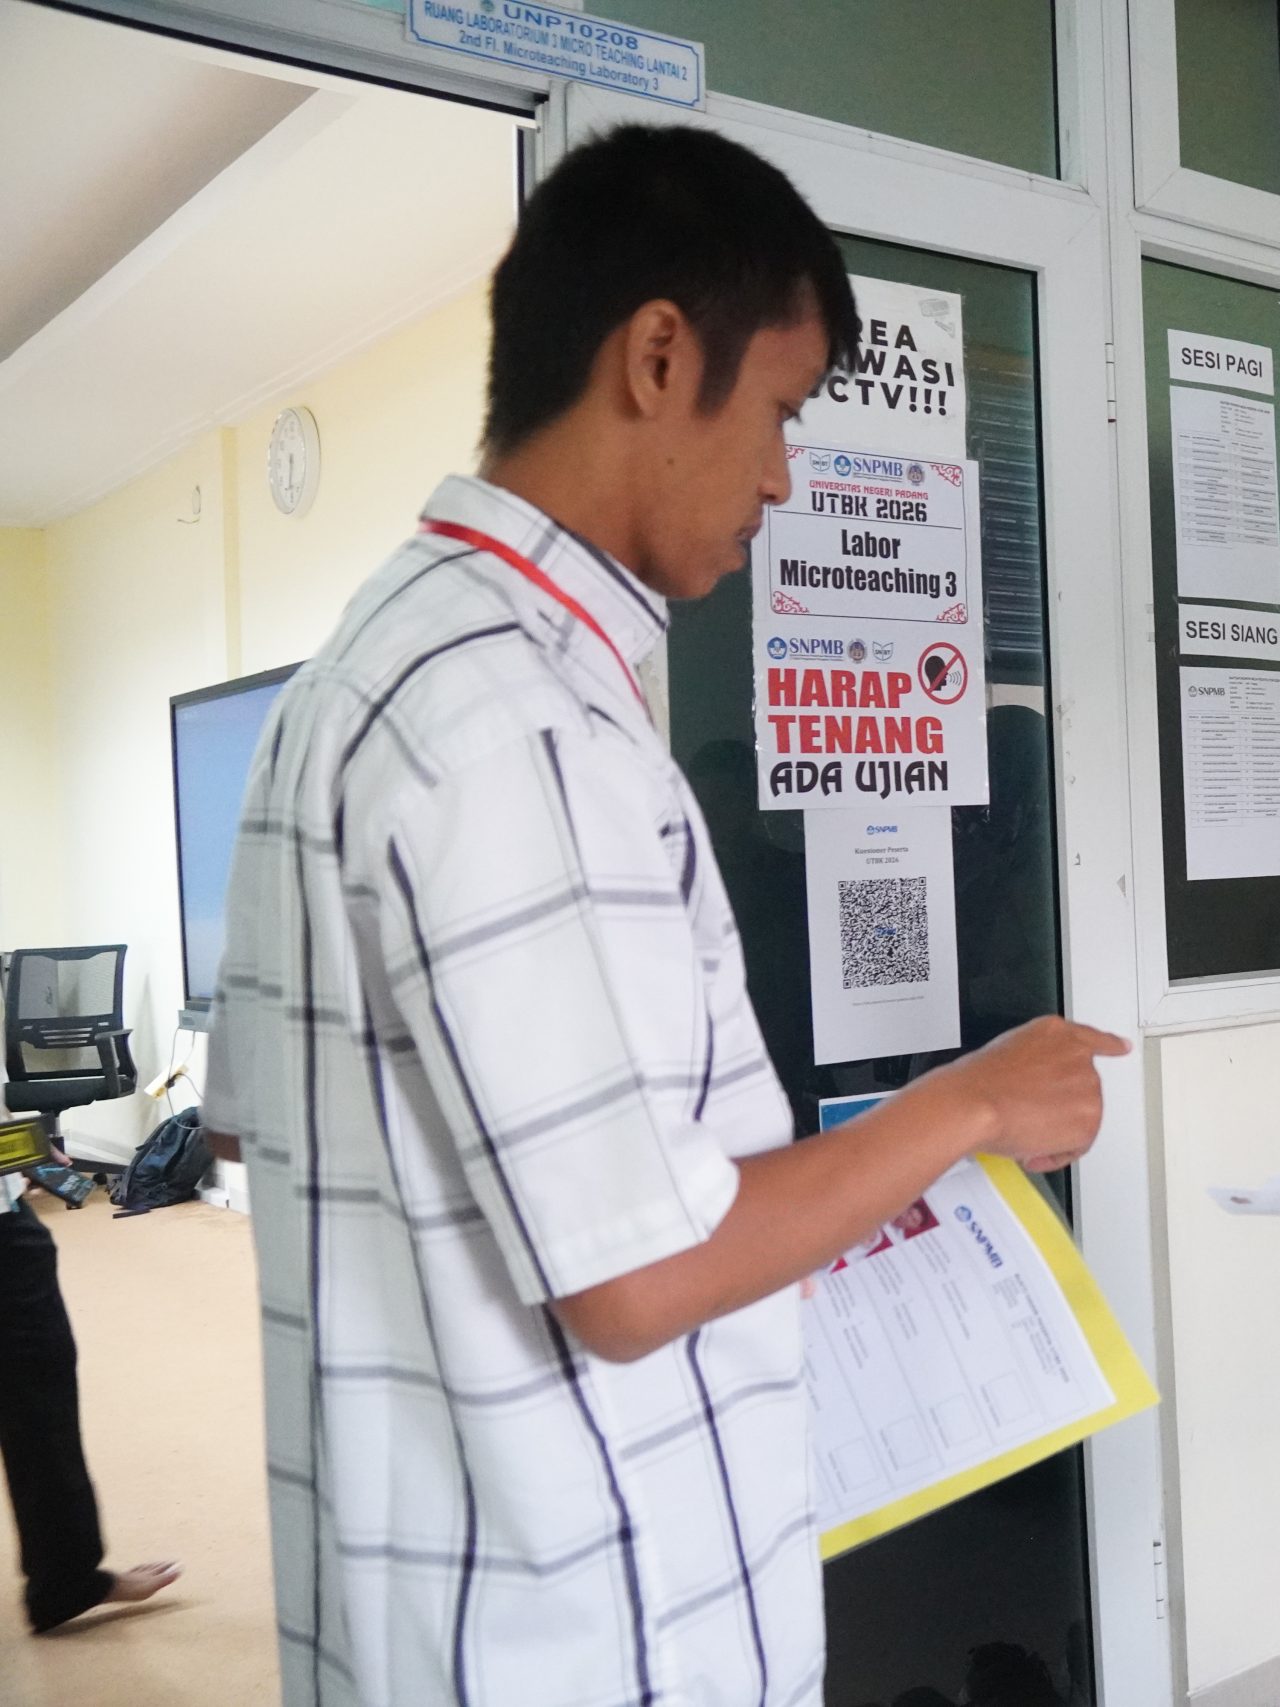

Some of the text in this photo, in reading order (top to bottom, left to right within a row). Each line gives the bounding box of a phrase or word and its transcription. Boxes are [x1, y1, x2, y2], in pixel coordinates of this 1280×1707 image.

[424, 1, 463, 24] RUANG
[466, 11, 549, 46] LABORATORIUM
[560, 35, 592, 57] MICRO
[595, 44, 644, 70] TEACHING
[646, 58, 680, 80] LANTAI
[682, 66, 688, 81] 2
[503, 3, 638, 50] UNP10208
[460, 30, 481, 47] 2nd
[503, 41, 586, 75] Microteaching
[589, 62, 650, 91] Laboratory
[652, 77, 659, 91] 3
[1181, 347, 1263, 379] SESI PAGI
[806, 375, 947, 416] CTV!!!
[853, 456, 903, 477] SNPMB
[809, 480, 928, 500] UNIVERSITAS NEGERI PADANG
[811, 491, 928, 522] UTBK 2026
[841, 529, 901, 560] Labor
[780, 559, 957, 599] Microteaching 3
[789, 637, 844, 655] SNPMB
[1185, 620, 1279, 645] SESI SIANG
[767, 667, 912, 709] HARAP
[1198, 686, 1226, 696] SNPMB
[767, 714, 944, 755] TENANG
[770, 760, 949, 799] ADA UJIAN
